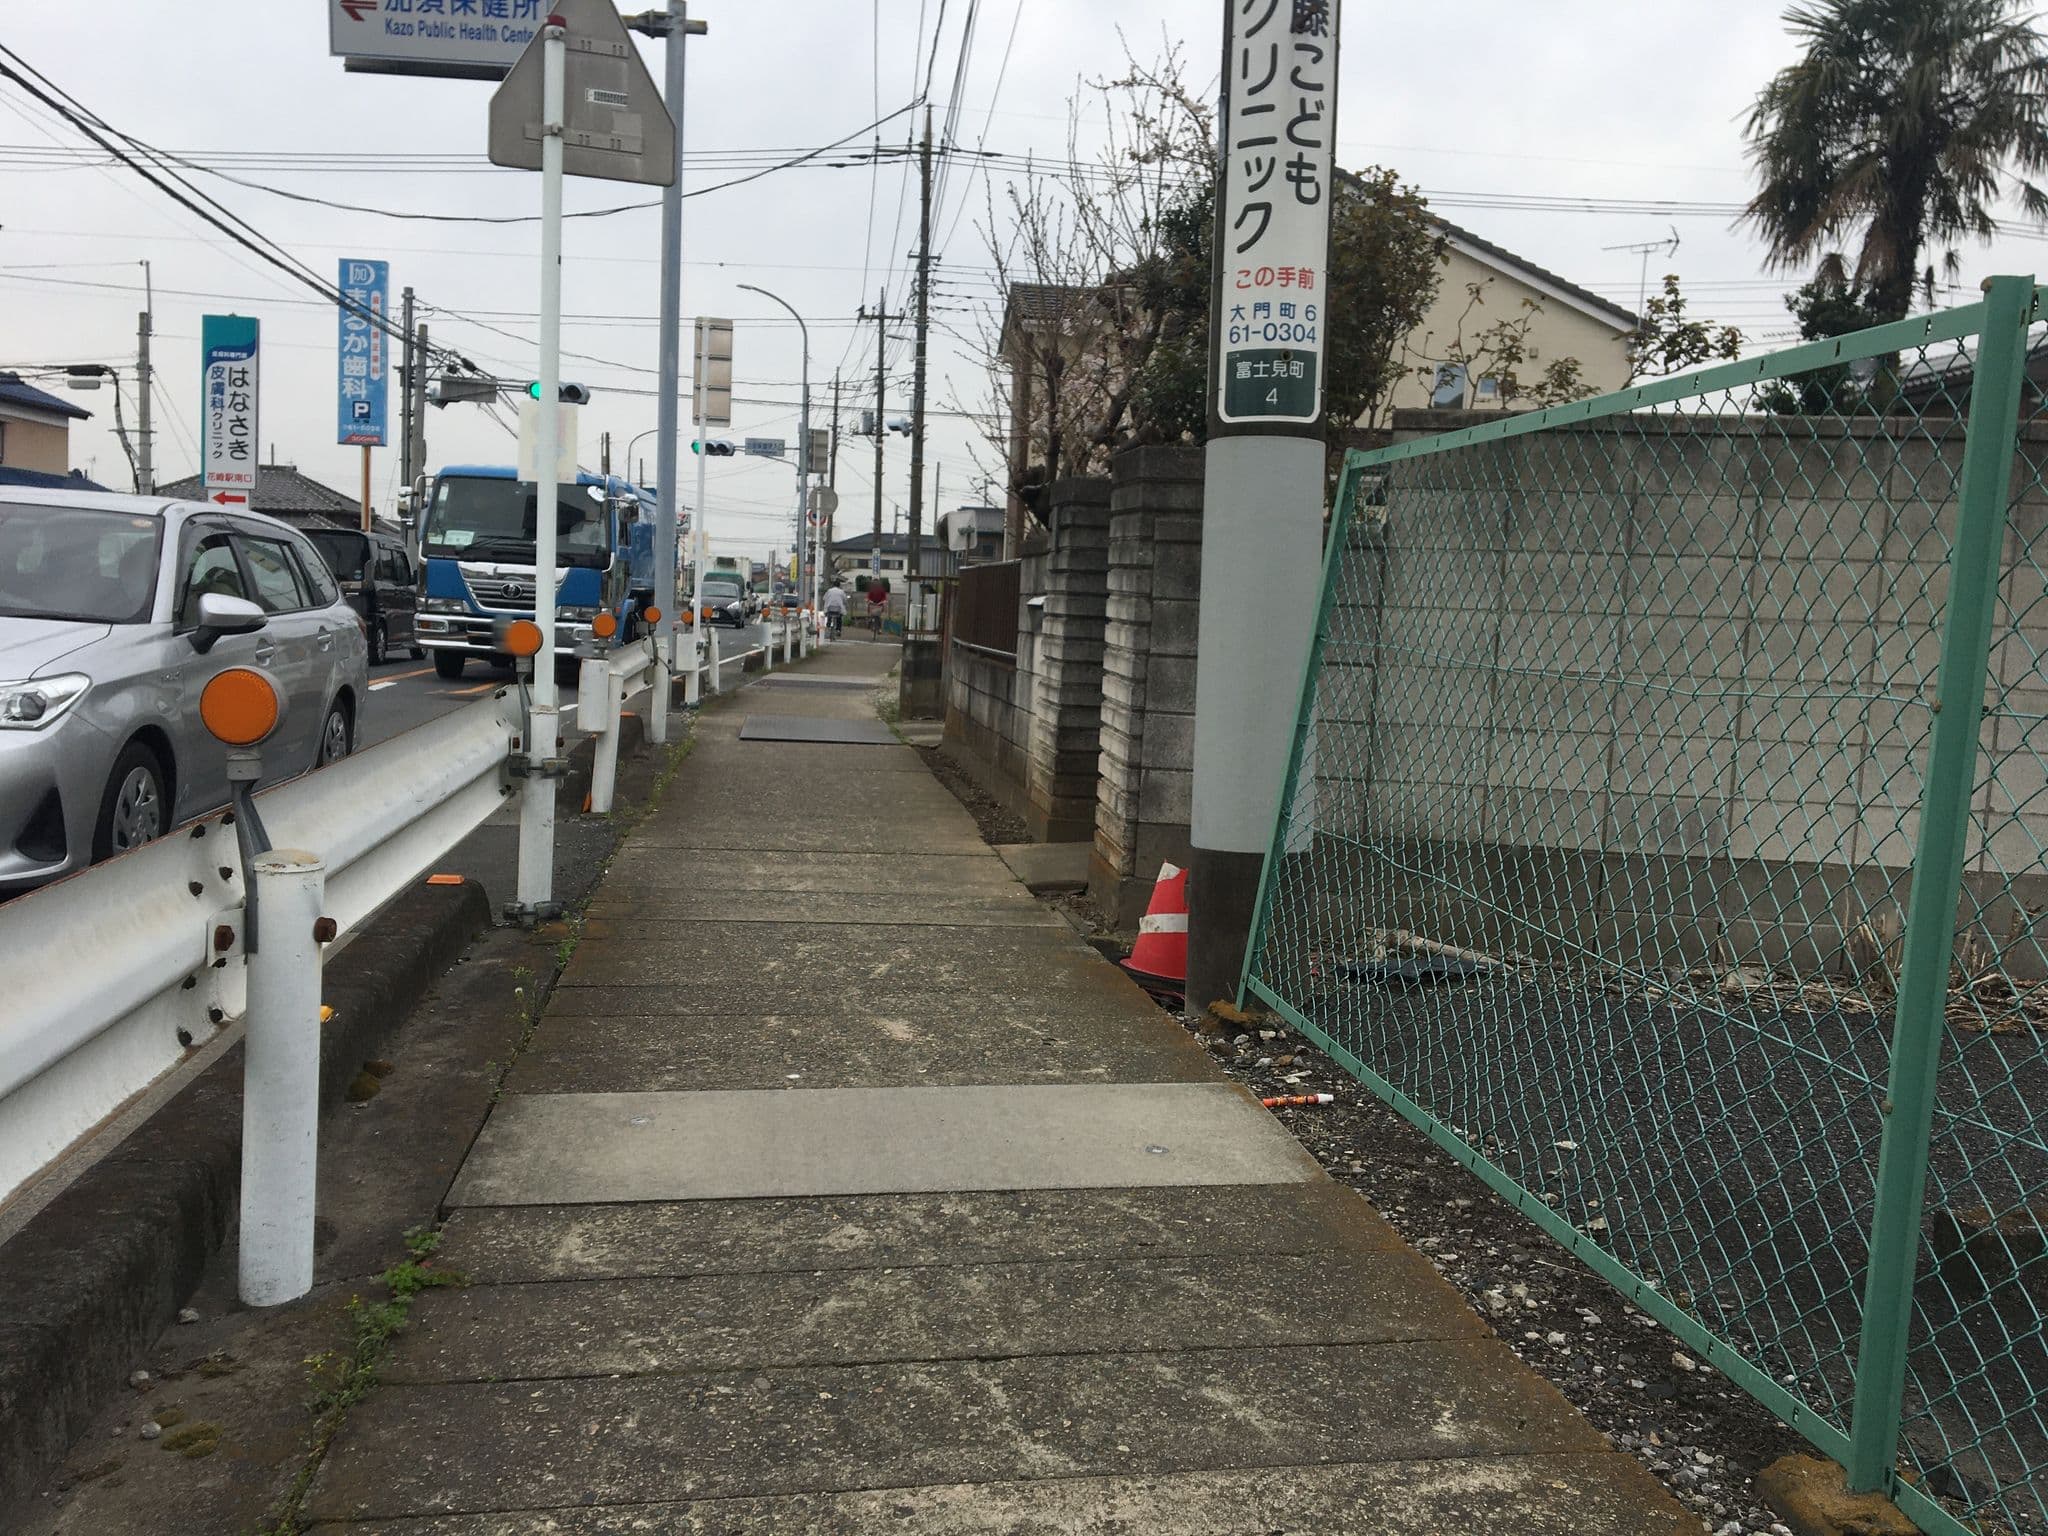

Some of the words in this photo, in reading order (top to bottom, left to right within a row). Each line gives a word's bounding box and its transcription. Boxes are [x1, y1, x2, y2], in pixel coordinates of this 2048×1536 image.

[384, 18, 414, 36] Kazo
[417, 20, 455, 39] Public
[459, 23, 498, 42] Health
[500, 25, 534, 43] Cente
[1234, 0, 1279, 254] クリニック
[1236, 266, 1315, 290] この手前
[343, 288, 368, 400] まるか歯科
[1229, 323, 1317, 344] 61-0304
[1235, 361, 1305, 379] 富士見町
[1265, 387, 1278, 405] 4
[210, 366, 225, 459] 皮膚科クリニック
[228, 367, 250, 461] はなさき
[354, 402, 370, 417] P
